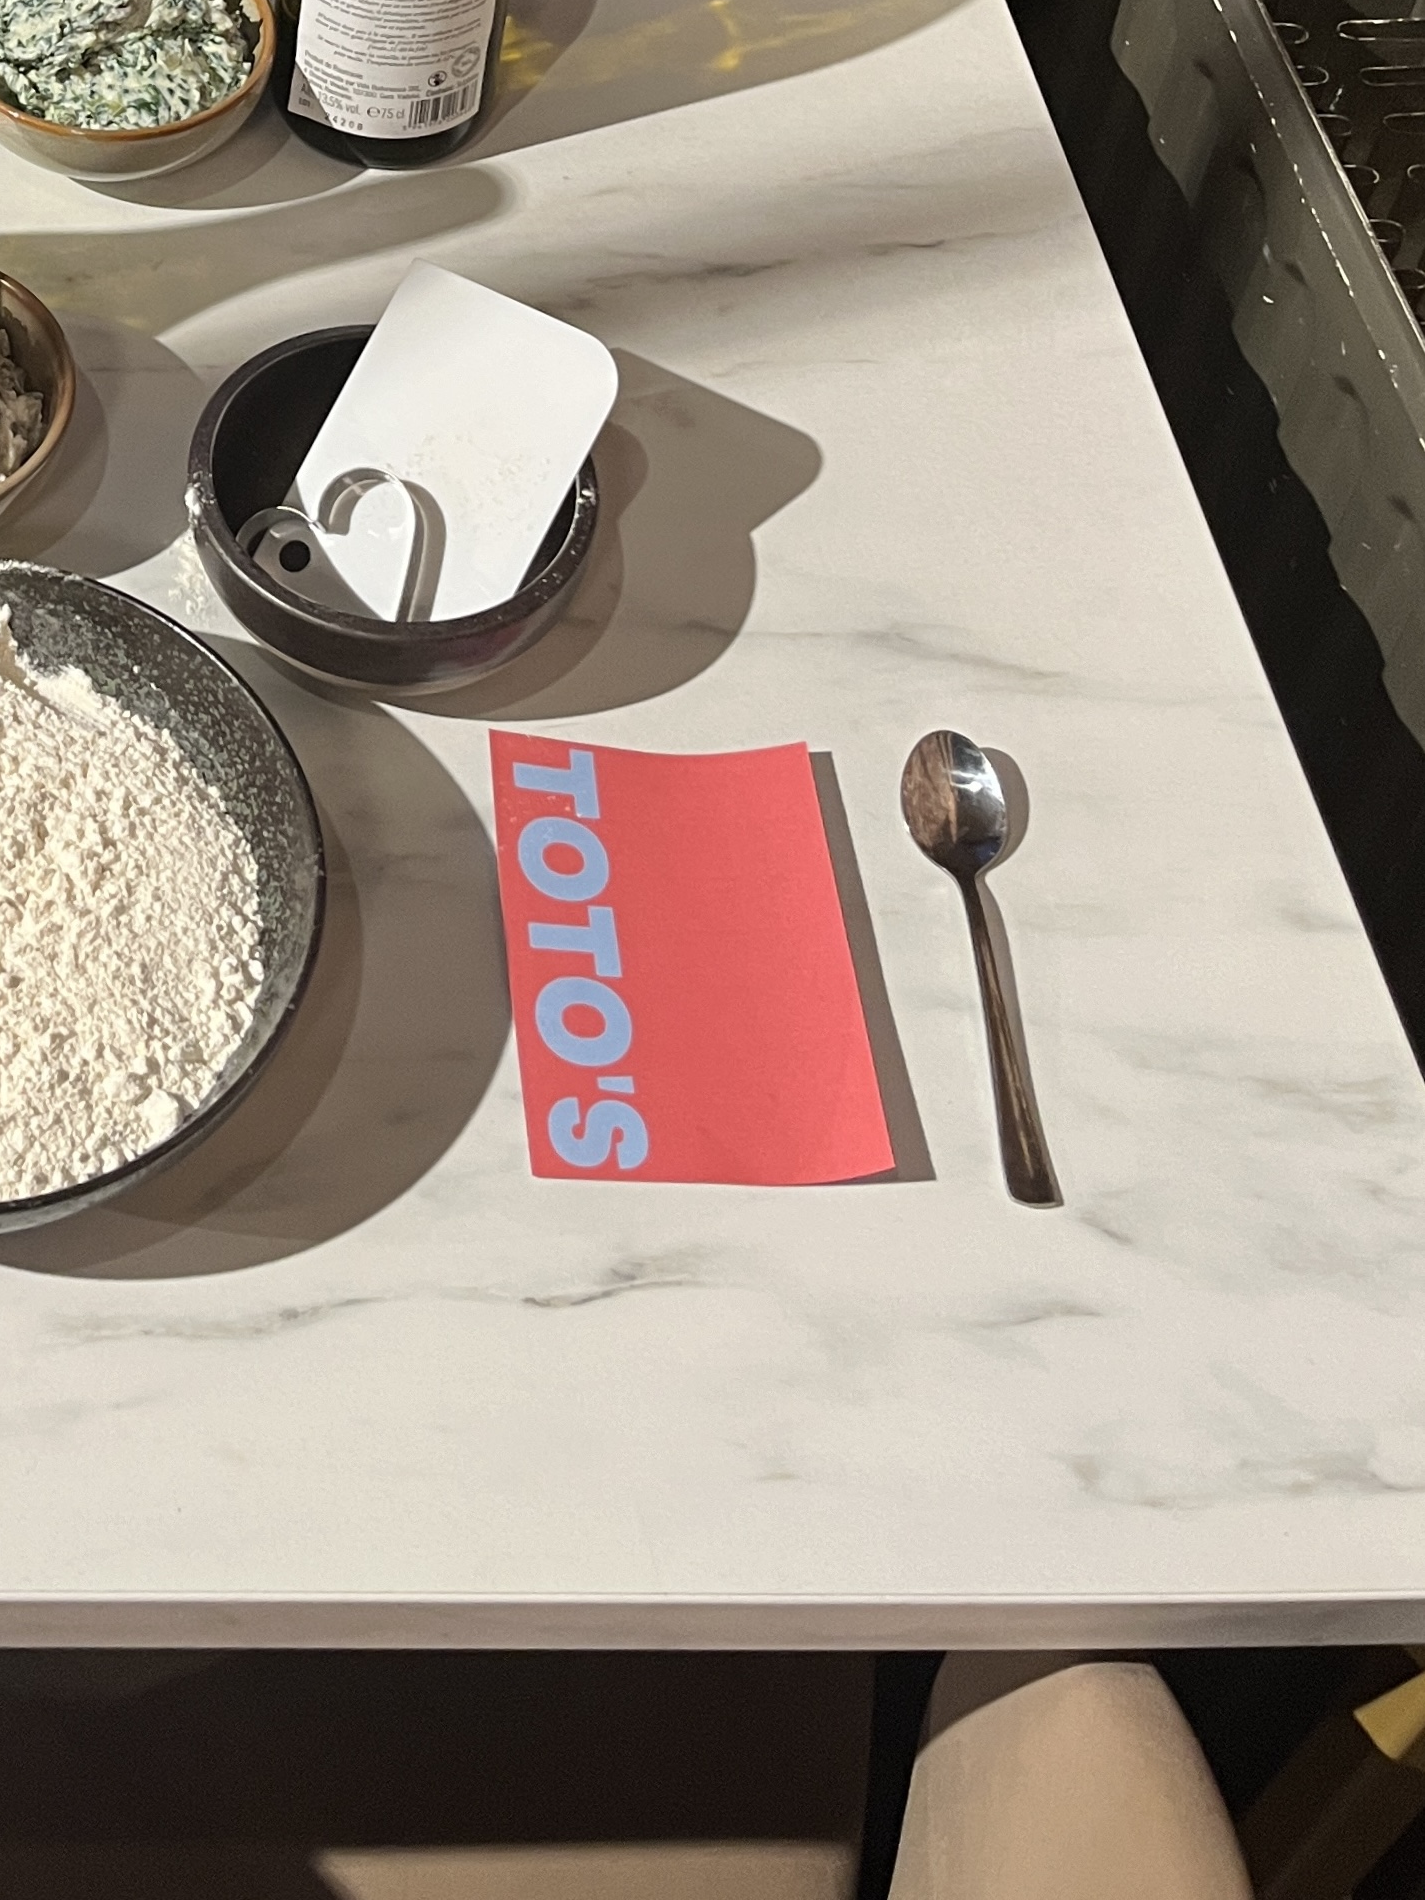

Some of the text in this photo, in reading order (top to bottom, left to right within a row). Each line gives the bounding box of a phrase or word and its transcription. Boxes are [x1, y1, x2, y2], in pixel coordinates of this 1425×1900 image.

[380, 107, 394, 120] 75
[396, 108, 406, 120] cl
[511, 748, 650, 1170] TOTO'S
